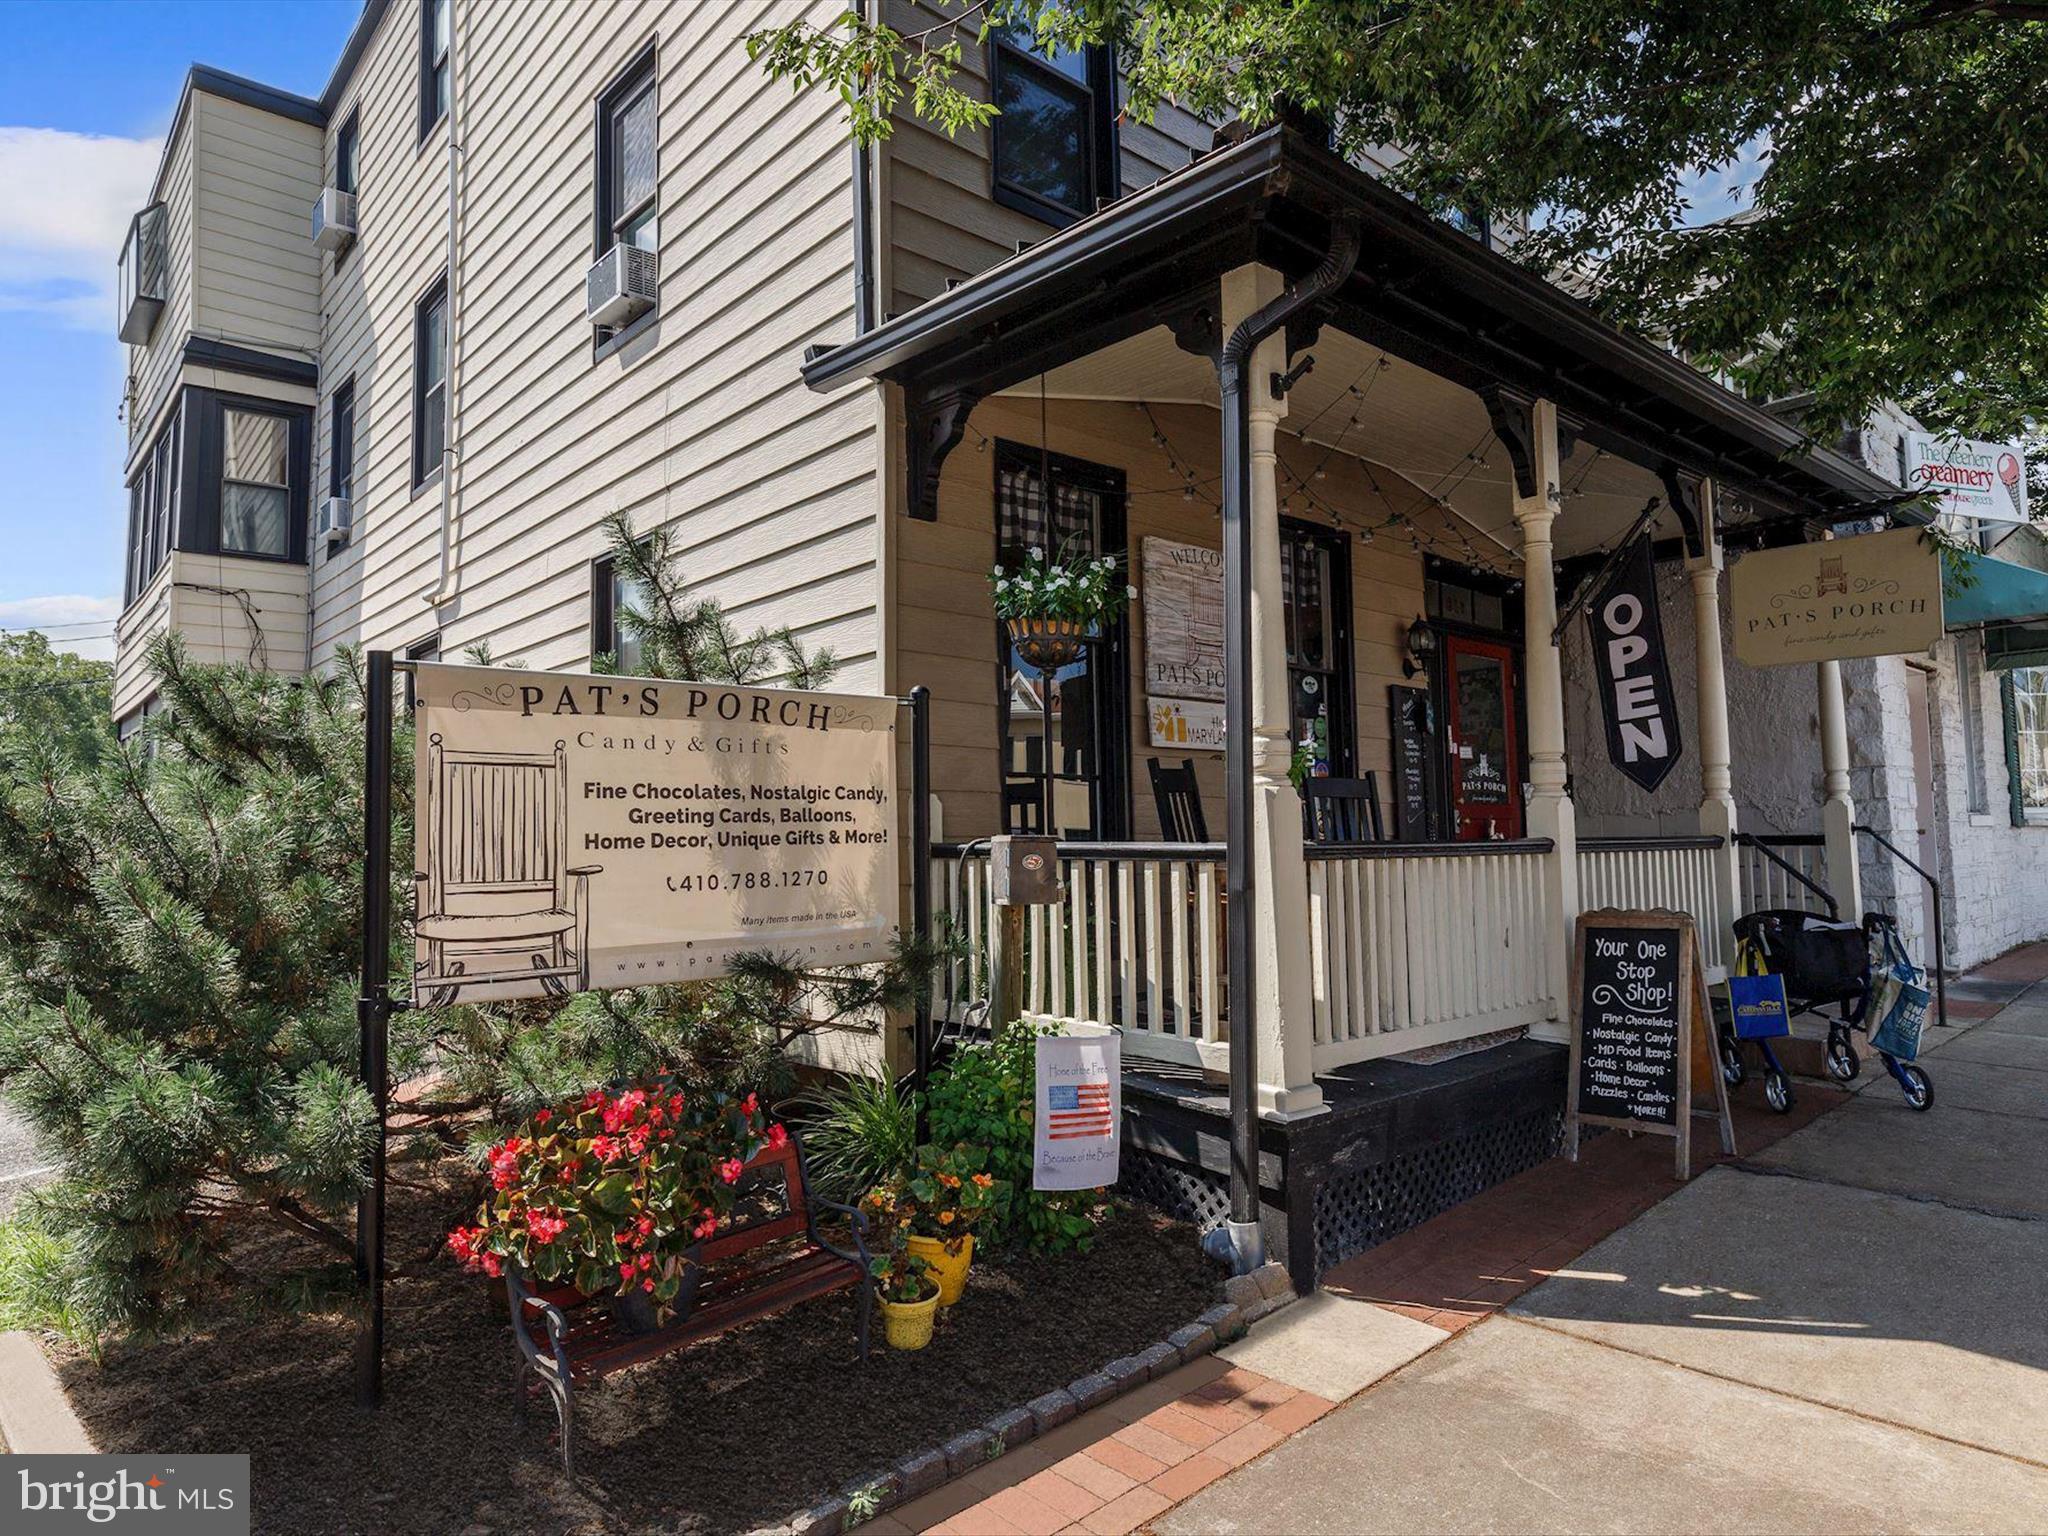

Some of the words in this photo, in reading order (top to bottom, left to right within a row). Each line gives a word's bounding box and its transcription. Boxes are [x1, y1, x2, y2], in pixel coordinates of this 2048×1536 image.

[1918, 442, 1939, 462] The
[1832, 599, 1926, 621] PORCH
[1603, 594, 1668, 763] OPEN
[520, 685, 659, 717] PAT'S
[687, 690, 831, 731] PORCH
[577, 731, 676, 755] Candy
[687, 739, 704, 753] &
[716, 737, 789, 755] Gifts
[583, 782, 627, 800] Fine
[632, 783, 746, 802] Chocolates,
[750, 784, 831, 804] Nostalgic
[835, 785, 888, 804] Candy,
[1483, 782, 1507, 793] PORCH
[628, 808, 714, 828] Greeting
[719, 808, 775, 826] Cards,
[780, 808, 857, 825] Balloons,
[584, 833, 646, 850] Home
[651, 832, 713, 850] Decor,
[717, 832, 781, 850] Unique
[785, 830, 825, 846] Gifts
[829, 831, 841, 844] &
[845, 829, 888, 844] More!
[679, 870, 829, 893] 410.788.1270
[741, 916, 765, 927] Many
[766, 915, 789, 925] items
[791, 913, 814, 923] made
[815, 912, 823, 921] in
[825, 911, 838, 921] the
[840, 910, 857, 920] USA
[617, 941, 872, 971] www.patch.com
[1595, 937, 1629, 957] Your
[1637, 940, 1667, 960] One
[1616, 961, 1656, 988] Stop
[1625, 981, 1673, 1007] Shop!
[1602, 1013, 1623, 1025] Fine
[1625, 1014, 1674, 1028] Chocolates
[1593, 1028, 1640, 1045] Nostalgic
[1645, 1032, 1673, 1047] Candy
[1598, 1044, 1615, 1055] MD
[1616, 1045, 1641, 1056] Food
[1071, 1064, 1080, 1075] of
[1080, 1064, 1091, 1075] the
[1091, 1062, 1109, 1075] Free
[1588, 1056, 1617, 1070] Cards
[1626, 1060, 1665, 1076] Balloons
[1595, 1070, 1621, 1085] Home
[1623, 1075, 1650, 1087] Decor
[1591, 1085, 1628, 1099] Puzzles
[1043, 1150, 1077, 1166] Because
[1077, 1151, 1085, 1163] of
[1086, 1150, 1096, 1161] the
[1097, 1148, 1116, 1162] Brave
